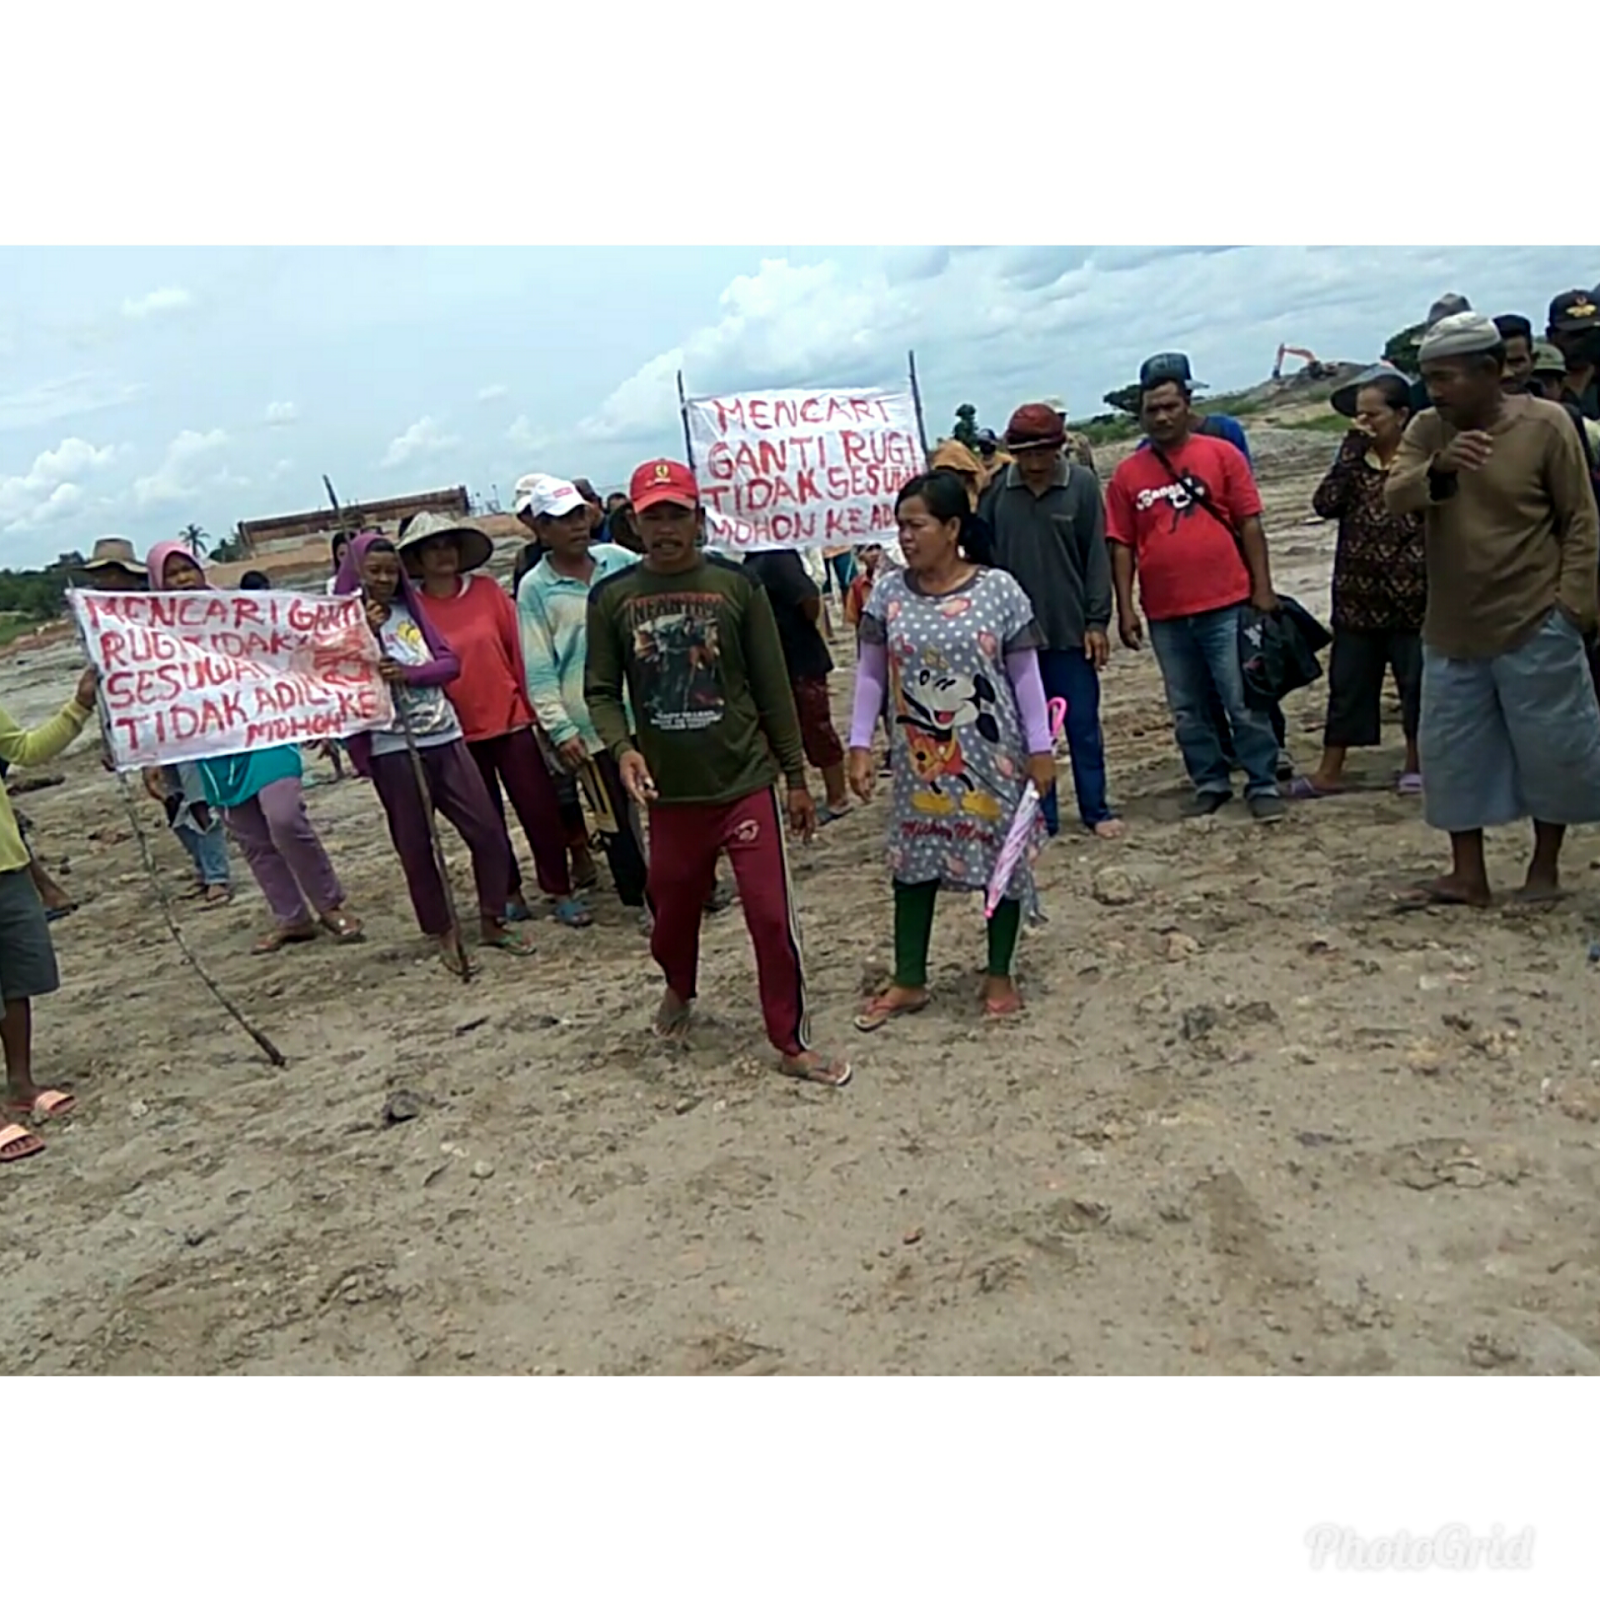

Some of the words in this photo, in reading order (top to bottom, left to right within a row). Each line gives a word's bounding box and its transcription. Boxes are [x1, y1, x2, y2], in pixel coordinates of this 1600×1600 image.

[712, 397, 890, 433] MENCARI
[707, 435, 826, 481] GANTI
[839, 429, 917, 464] RUGI
[700, 470, 822, 515] TIDAK
[709, 511, 816, 545] MOHON
[84, 595, 277, 630] MENCARI
[289, 598, 361, 635] GANTI
[115, 690, 249, 751] TIDAK
[244, 711, 343, 749] MOHON
[335, 689, 378, 723] KE
